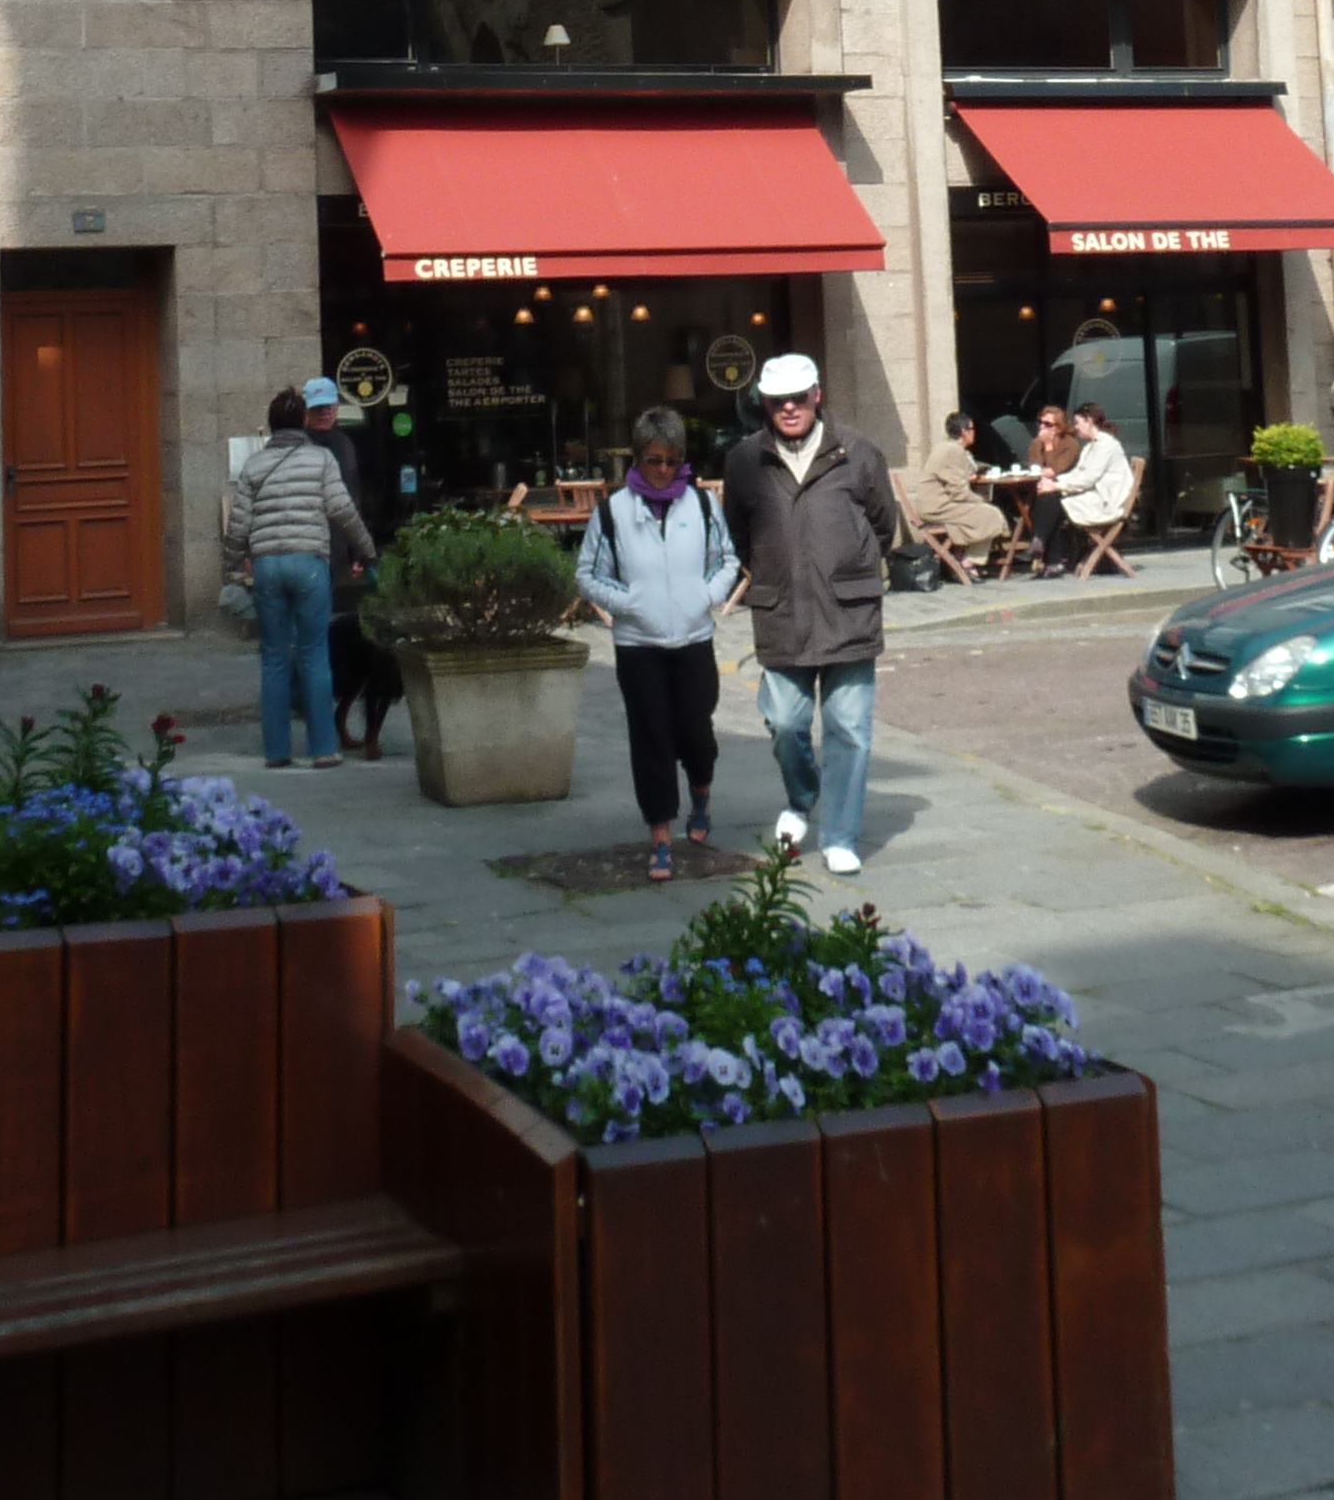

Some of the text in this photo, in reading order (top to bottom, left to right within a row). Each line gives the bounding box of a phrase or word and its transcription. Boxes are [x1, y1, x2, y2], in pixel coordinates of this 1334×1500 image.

[1071, 230, 1230, 251] SALON DE THE
[414, 257, 538, 279] CREPERIE
